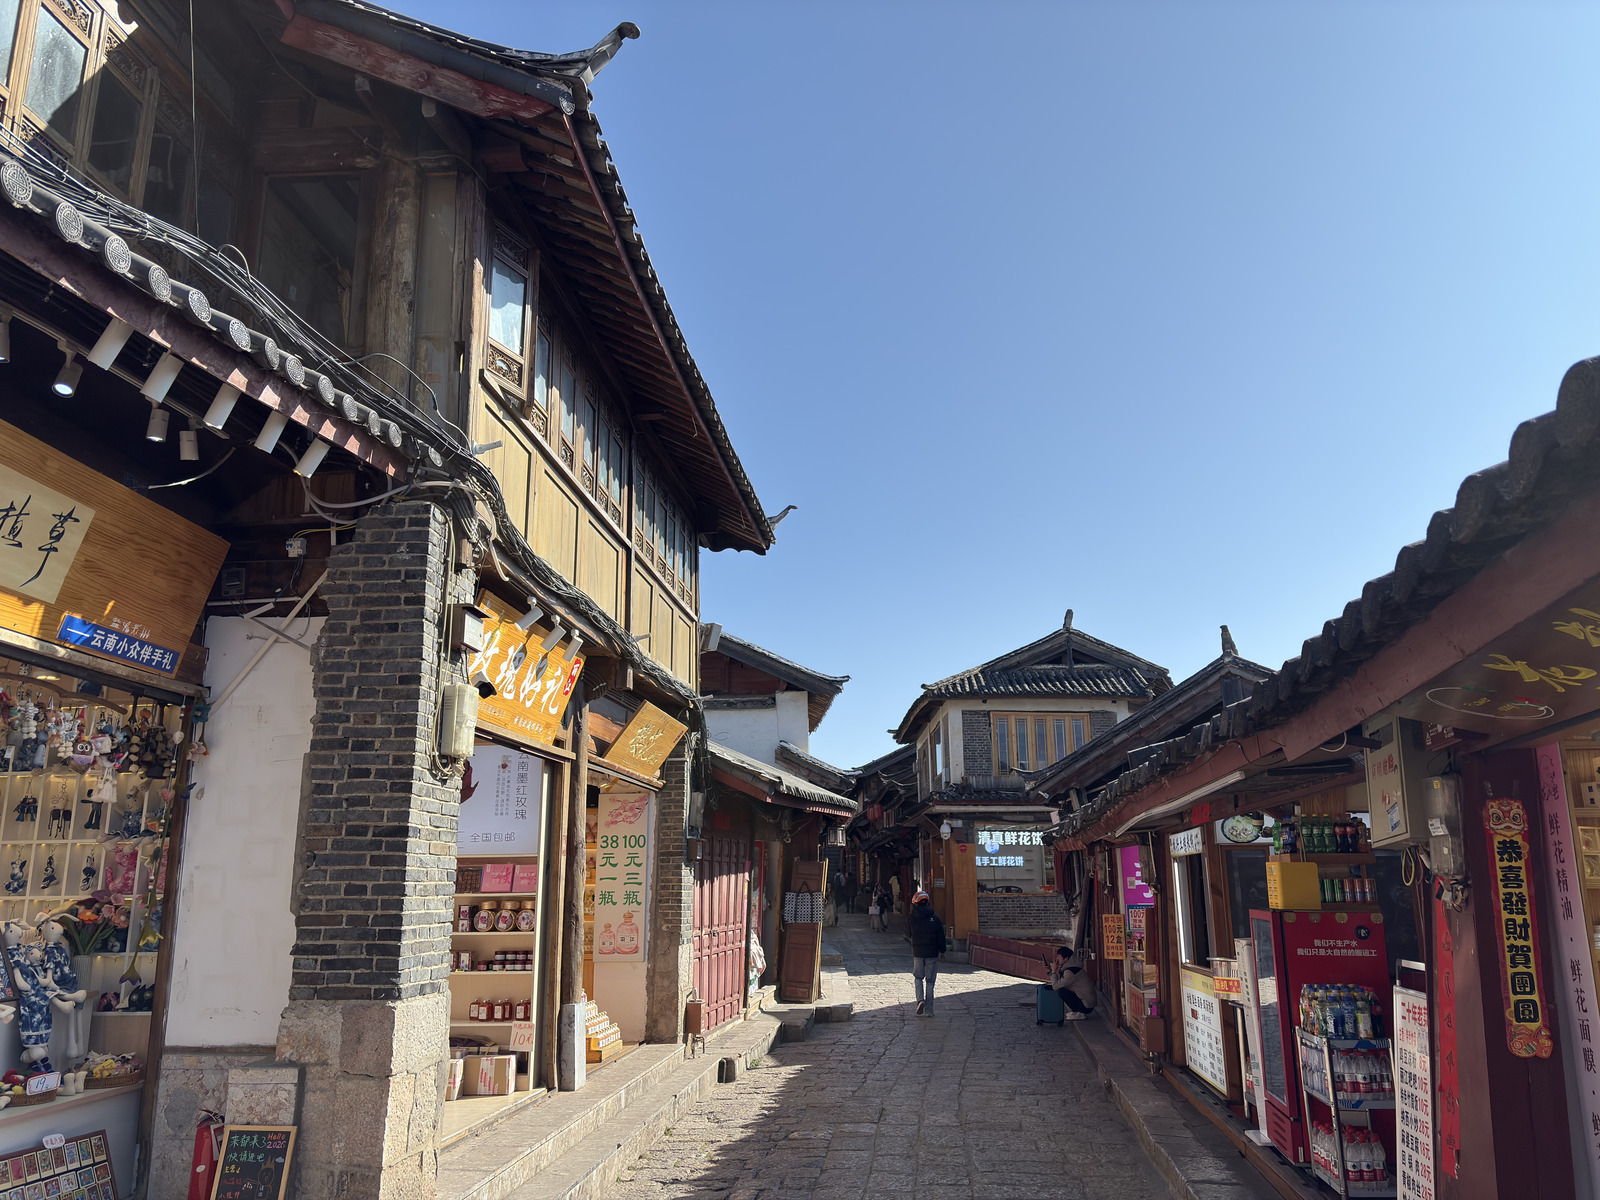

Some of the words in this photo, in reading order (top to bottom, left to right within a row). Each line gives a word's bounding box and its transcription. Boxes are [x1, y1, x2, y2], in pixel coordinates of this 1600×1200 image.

[90, 629, 174, 670] 云南小众伴手礼
[515, 753, 529, 821] 云南墨红玫瑰
[470, 832, 516, 843] 全国包邮
[1104, 924, 1123, 934] 100元
[1496, 839, 1540, 1024] 恭喜發財賀團圓
[1314, 939, 1358, 948] 我们不生产水
[1548, 812, 1574, 921] 鲜花精油
[1570, 958, 1597, 1074] 鲜花面膜
[1296, 948, 1377, 957] 我们只是大自然的搬运工
[228, 1133, 266, 1149] 来都来了
[267, 1132, 286, 1140] Hello
